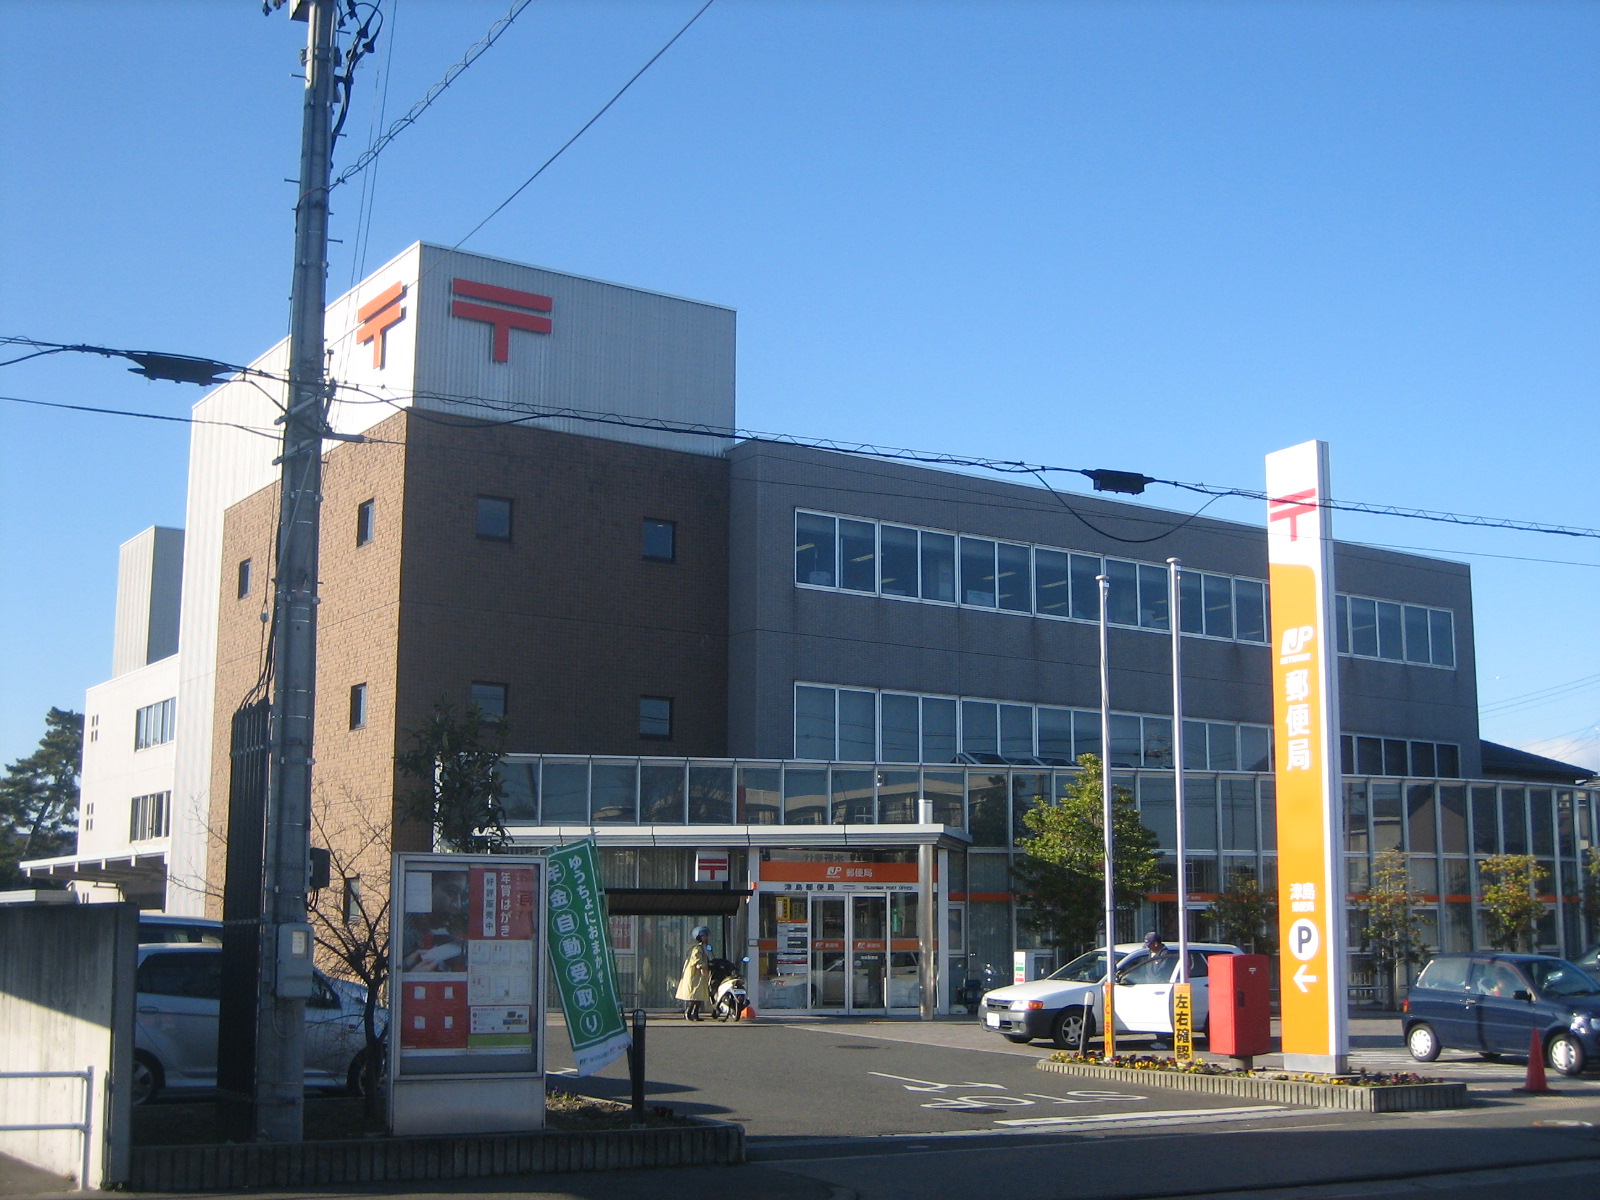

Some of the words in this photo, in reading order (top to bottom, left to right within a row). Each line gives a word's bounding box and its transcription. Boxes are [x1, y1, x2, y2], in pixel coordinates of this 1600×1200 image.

[1285, 669, 1311, 771] 郵便局
[784, 883, 835, 891] 津島郵便局
[846, 868, 872, 877] 郵便局
[1290, 882, 1315, 900] 津島
[486, 878, 494, 930] 好評販売中
[500, 872, 512, 937] 年賀はがき
[548, 864, 599, 1032] 年金自動受取り
[1297, 926, 1312, 953] P
[1175, 994, 1190, 1060] 左右確認
